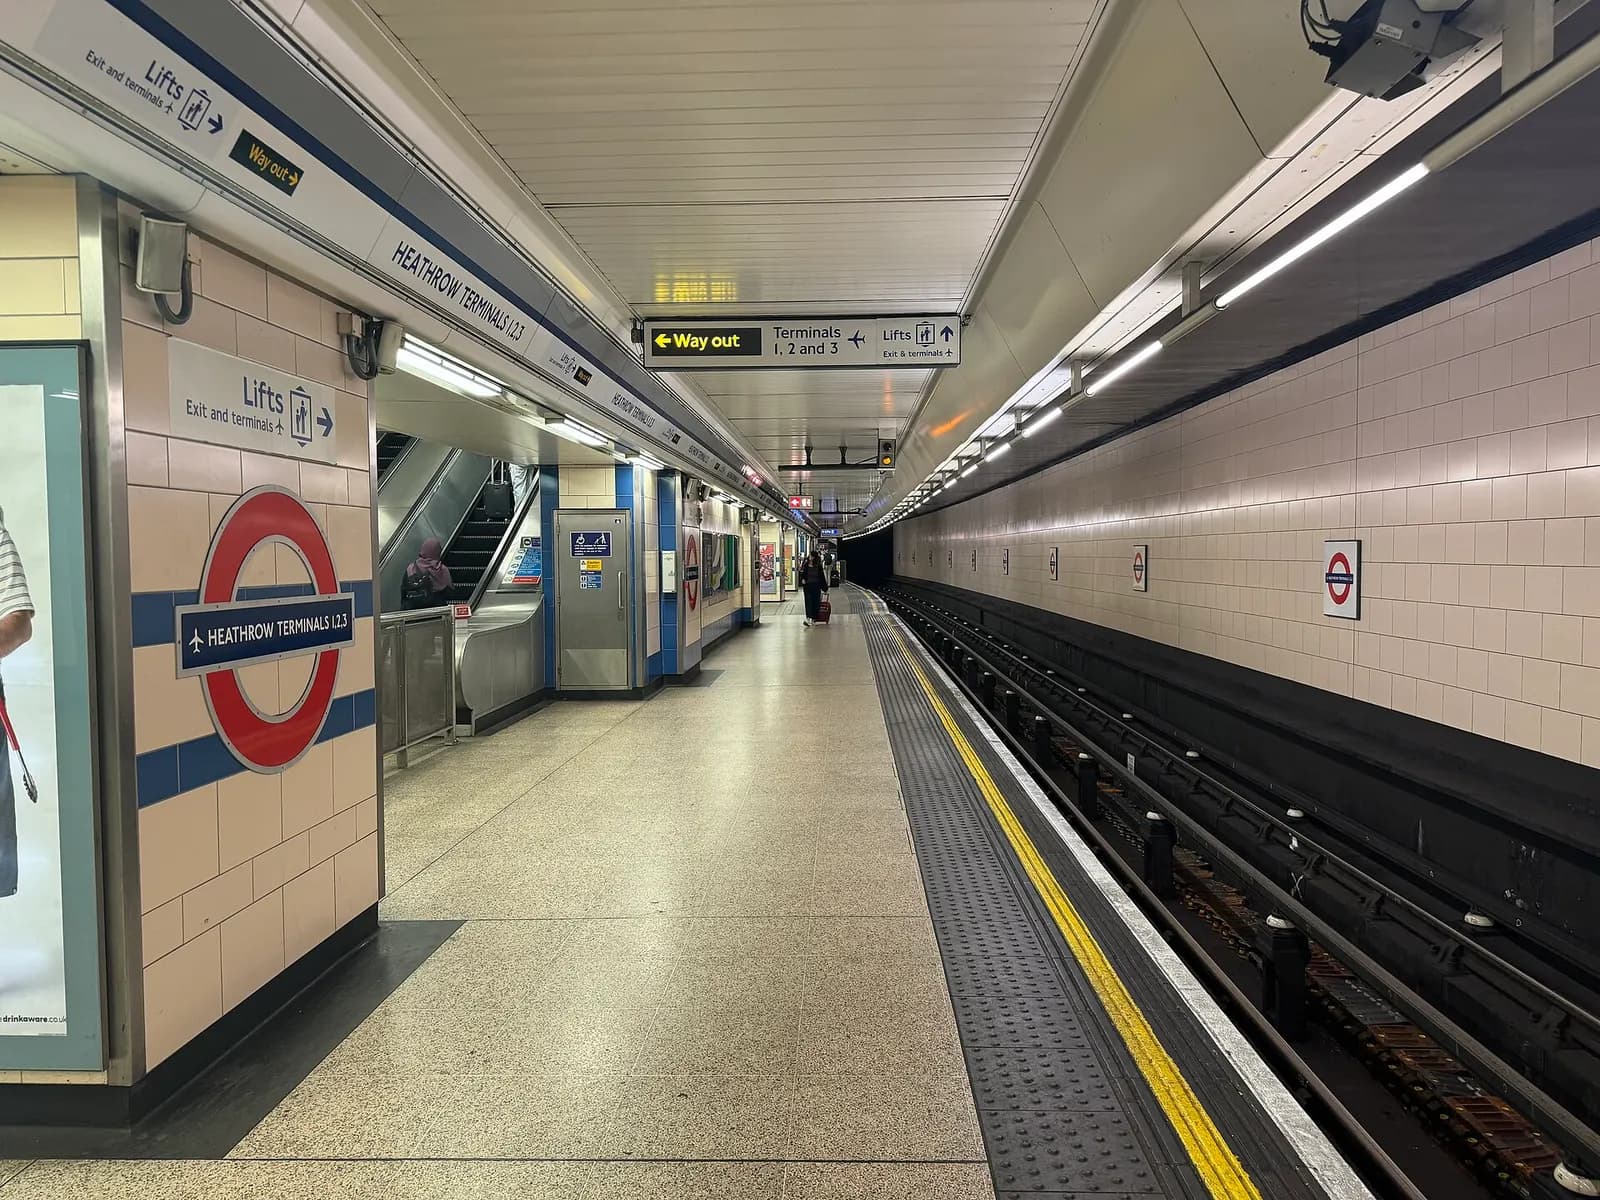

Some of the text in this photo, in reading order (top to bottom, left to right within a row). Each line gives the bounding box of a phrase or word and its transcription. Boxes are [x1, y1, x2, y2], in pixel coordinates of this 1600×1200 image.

[86, 49, 164, 108] Exit and terminals
[145, 60, 184, 100] Lifts
[248, 143, 289, 181] Way out
[391, 241, 463, 299] HEATHROW
[459, 286, 510, 331] TERMINALS
[673, 333, 740, 351] Way out
[773, 326, 841, 339] Terminals
[788, 343, 796, 355] 2
[799, 342, 825, 355] and
[830, 342, 839, 355] 3
[883, 329, 912, 341] Lifts
[883, 349, 943, 358] Exit & terminals
[243, 376, 284, 414] Lifts
[186, 398, 274, 433] Exit and terminals
[207, 621, 274, 647] HEATHROW
[277, 615, 330, 637] TERMINALS
